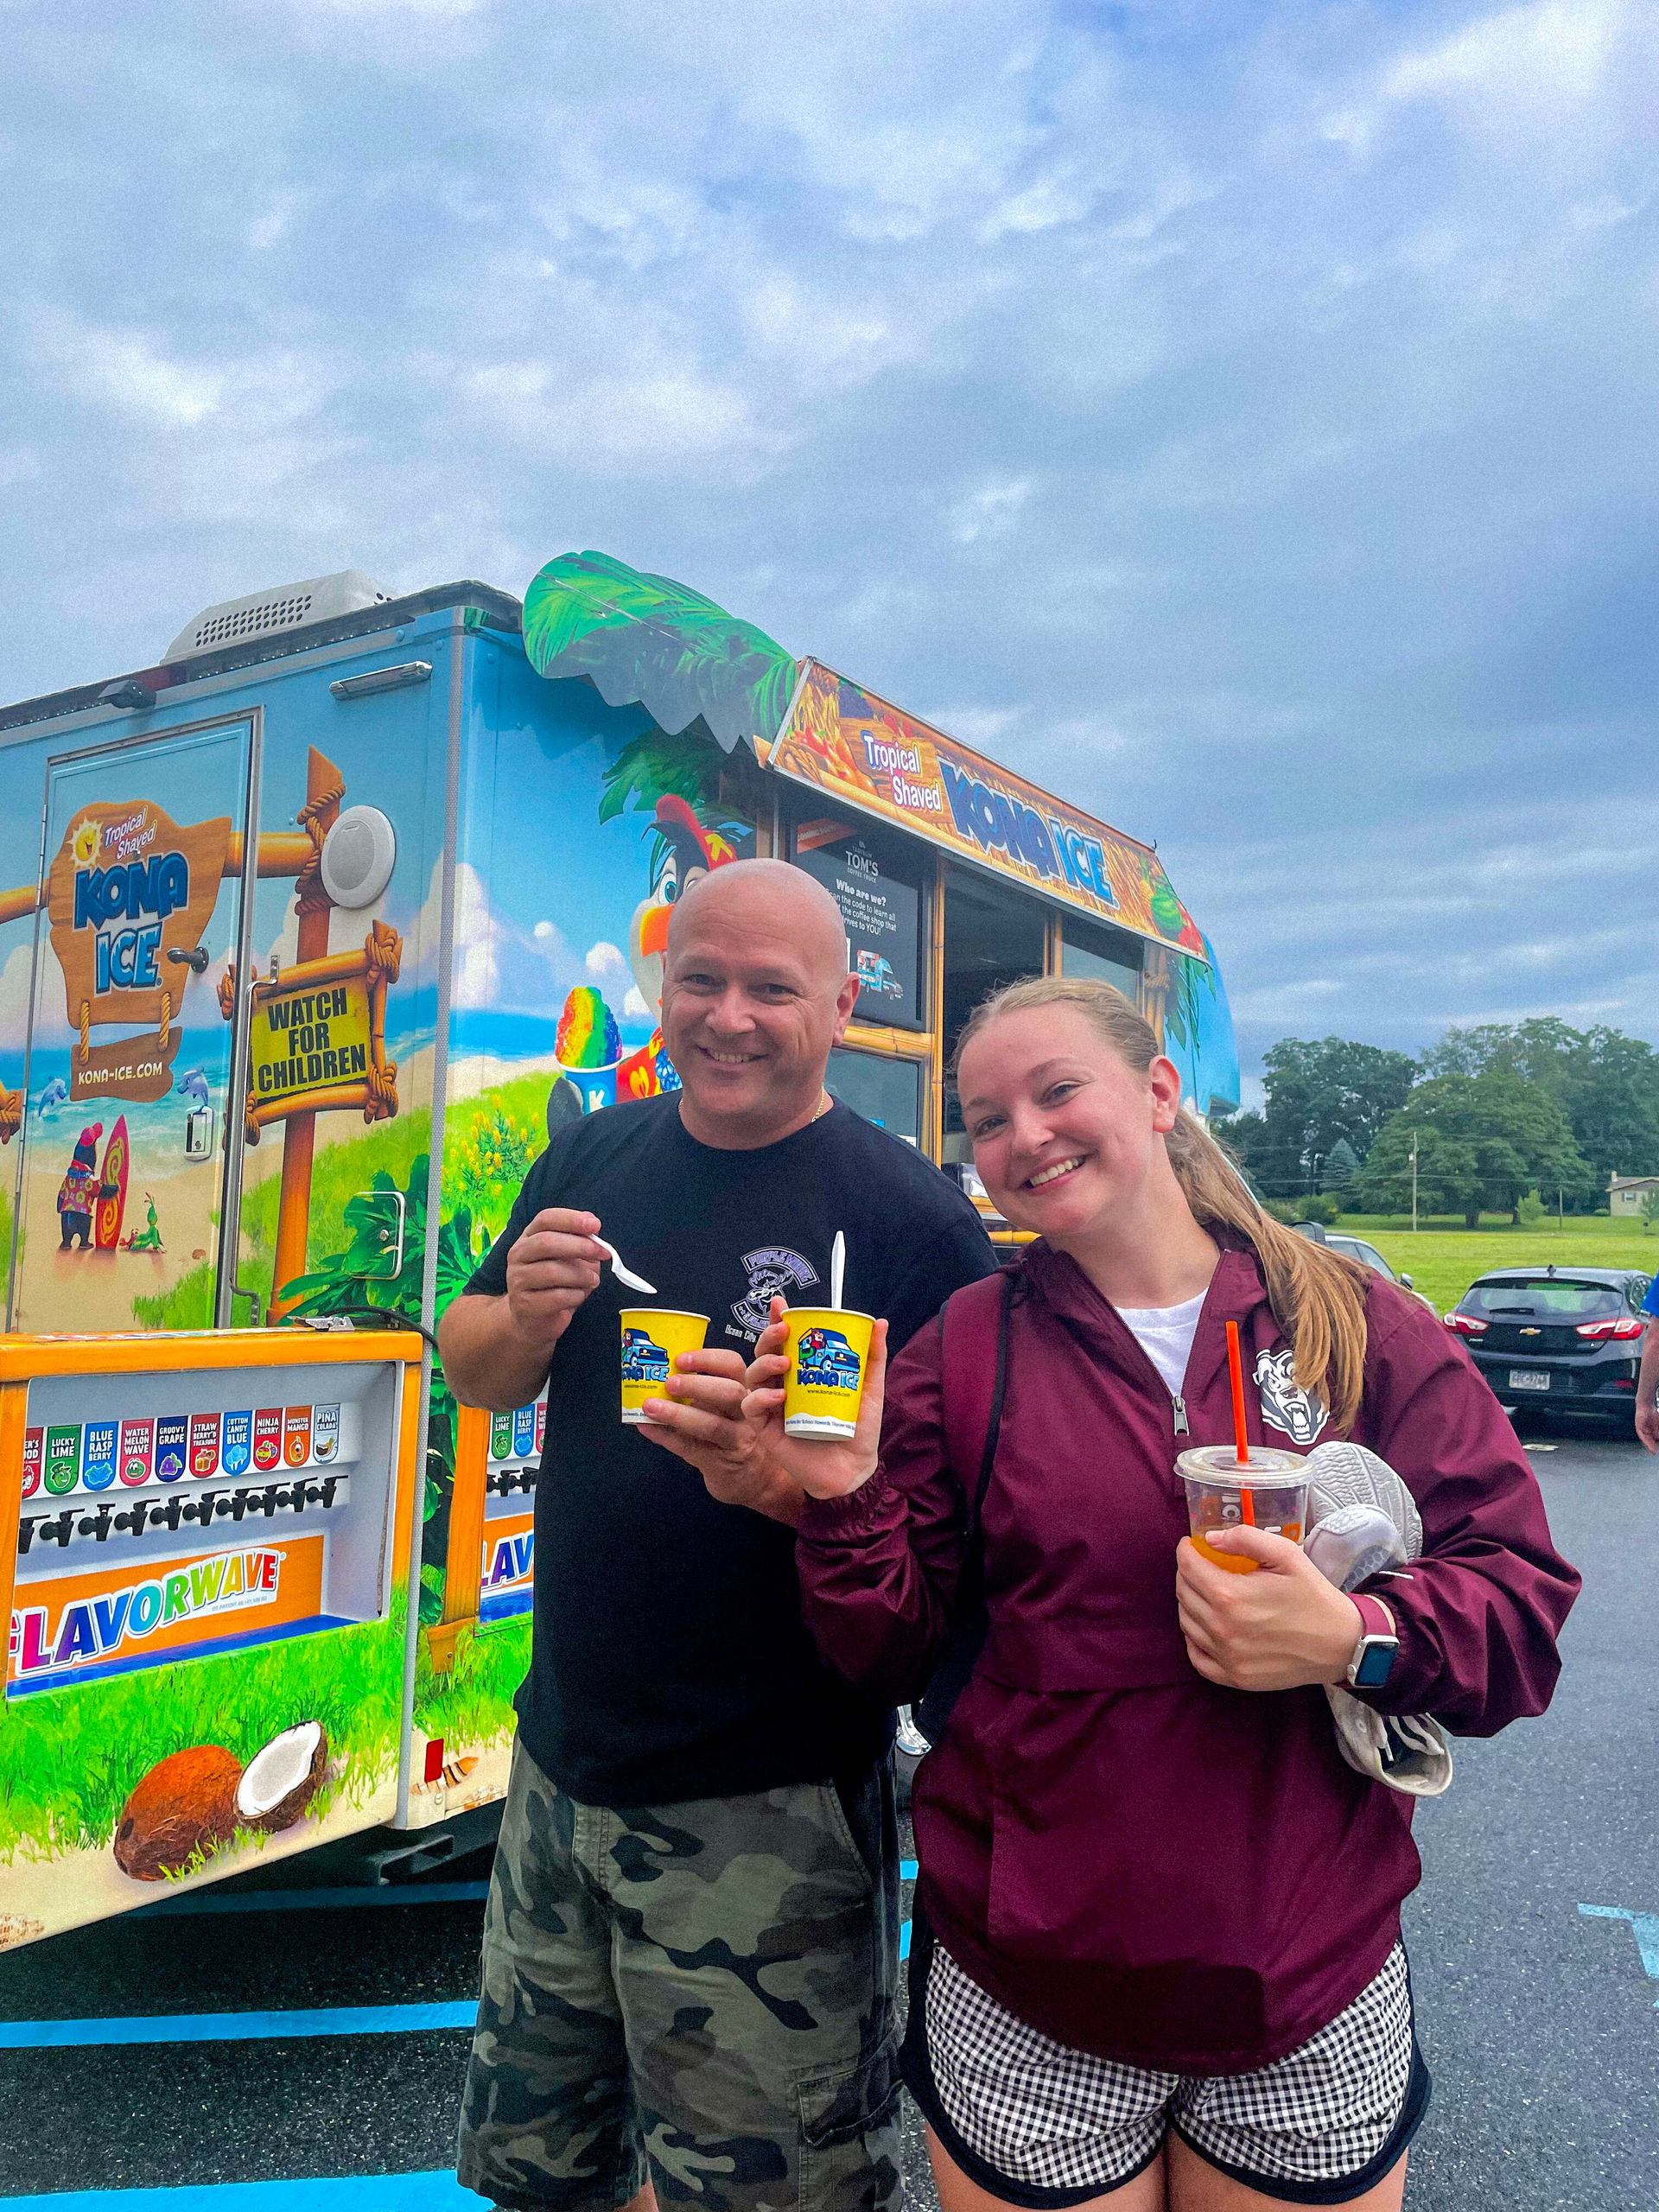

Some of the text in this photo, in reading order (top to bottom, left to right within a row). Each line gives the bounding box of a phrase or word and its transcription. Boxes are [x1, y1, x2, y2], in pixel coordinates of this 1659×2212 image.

[864, 734, 921, 775] Tropical
[893, 776, 942, 811] Shaved
[105, 807, 148, 847] Tropical
[938, 757, 1116, 907] KONA ICE
[118, 823, 156, 859] Shaved
[845, 850, 879, 876] TOM'S
[847, 868, 877, 883] COFFEE TRUCK
[73, 852, 189, 931] KONA
[836, 879, 887, 906] Who are we?
[841, 893, 851, 906] the
[851, 899, 866, 911] code
[866, 904, 873, 913] to
[873, 906, 888, 918] learn
[842, 905, 852, 916] the
[852, 910, 870, 922] coffee
[870, 916, 885, 928] shop
[885, 921, 897, 932] that
[859, 921, 866, 931] to
[866, 923, 881, 936] YOU!
[267, 987, 347, 1032] WATCH
[288, 1022, 330, 1057] FOR
[79, 1062, 162, 1085] KONA-ICE.COM
[257, 1043, 366, 1092] CHILDREN
[724, 1324, 744, 1338] Ocean
[622, 1365, 670, 1382] ONA ICE
[797, 1369, 860, 1391] KONA ICE
[316, 1410, 337, 1423] PIÑA
[518, 1410, 532, 1420] BLUE
[193, 1422, 218, 1433] STRAW
[226, 1417, 249, 1426] COTTON
[257, 1417, 279, 1427] NINJA
[287, 1422, 309, 1433] MANGO
[316, 1421, 336, 1430] COLADA
[495, 1422, 511, 1432] LIME
[518, 1419, 532, 1428] RASP
[124, 1427, 149, 1437] WATER
[159, 1425, 186, 1435] GROOVY
[226, 1424, 248, 1433] CANDY
[256, 1426, 279, 1436] CHERRY
[89, 1430, 114, 1442] BLUE
[124, 1435, 149, 1446] MELON
[159, 1433, 185, 1445] GRAPE
[193, 1431, 217, 1440] BERRY'D
[226, 1433, 248, 1445] BLUE
[24, 1440, 40, 1450] ER'S
[51, 1437, 76, 1447] LUCKY
[89, 1441, 113, 1453] RASP
[193, 1438, 217, 1446] TREASURE
[50, 1446, 75, 1459] LIME
[124, 1444, 149, 1456] WAVE
[88, 1452, 112, 1462] BERRY
